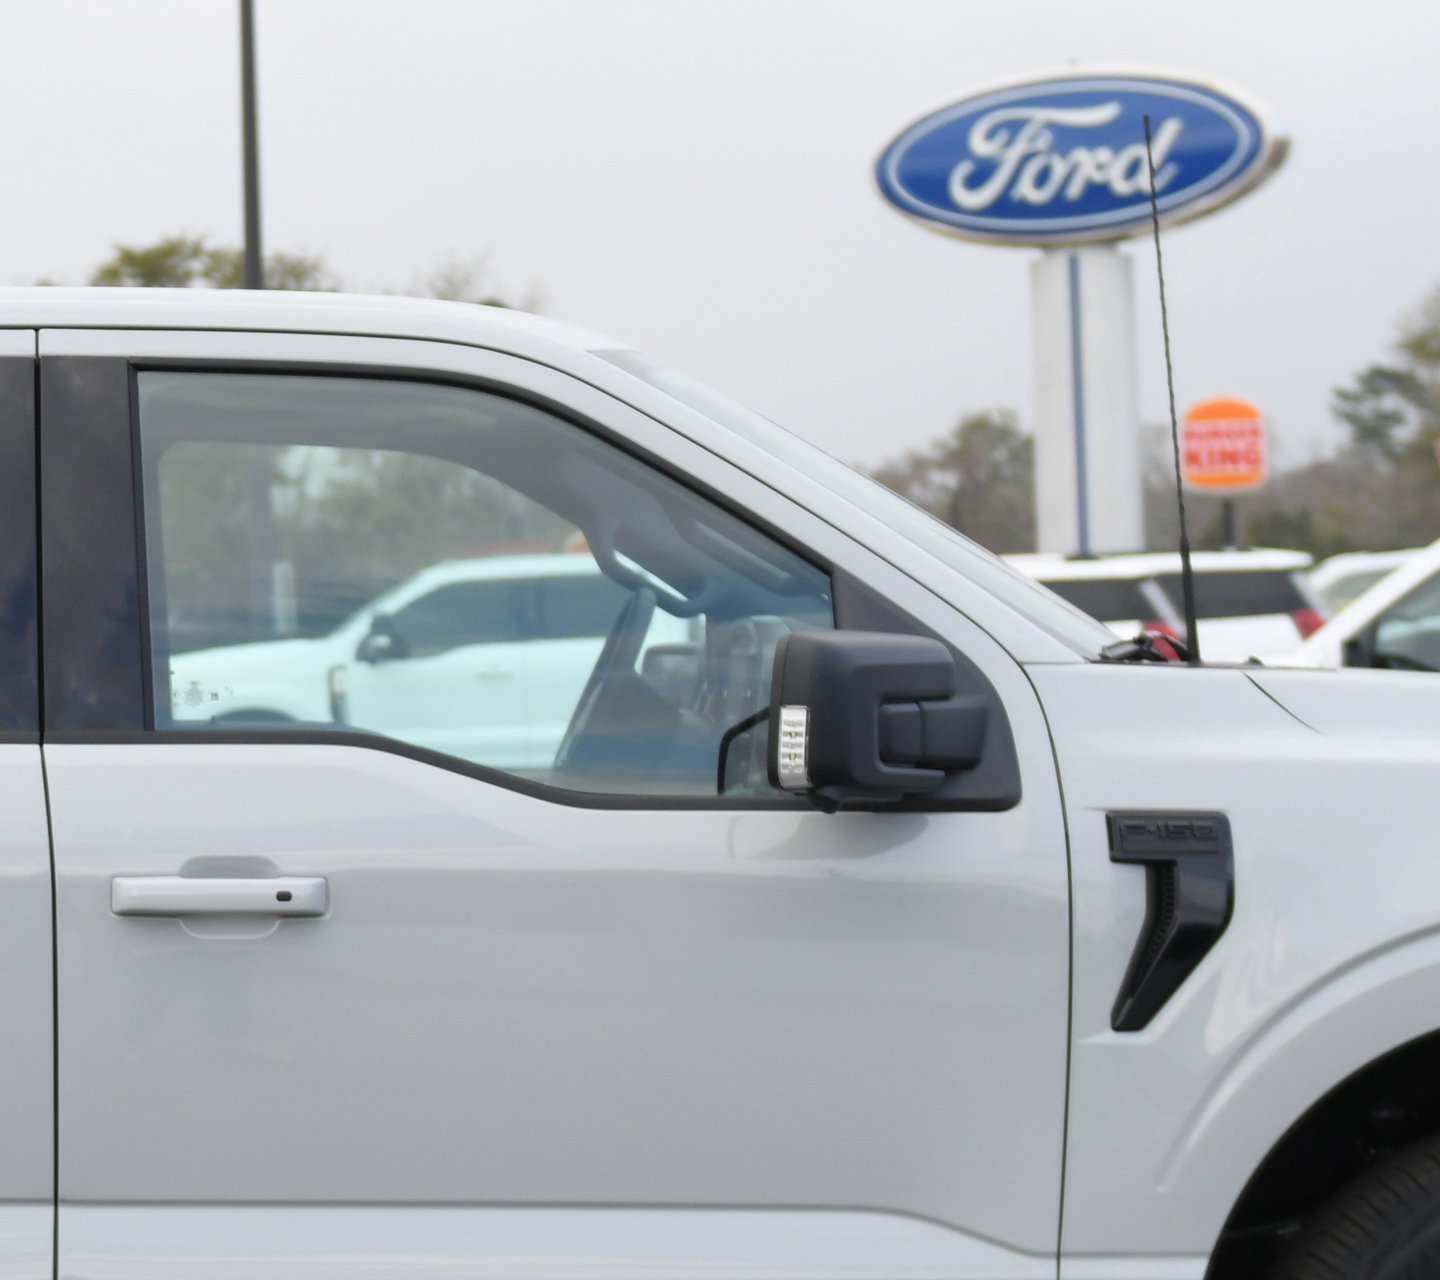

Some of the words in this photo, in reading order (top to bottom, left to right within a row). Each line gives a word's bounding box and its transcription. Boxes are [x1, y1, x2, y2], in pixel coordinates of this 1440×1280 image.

[949, 101, 1183, 210] Ford
[1184, 448, 1261, 467] KING
[1119, 821, 1218, 841] F-150
